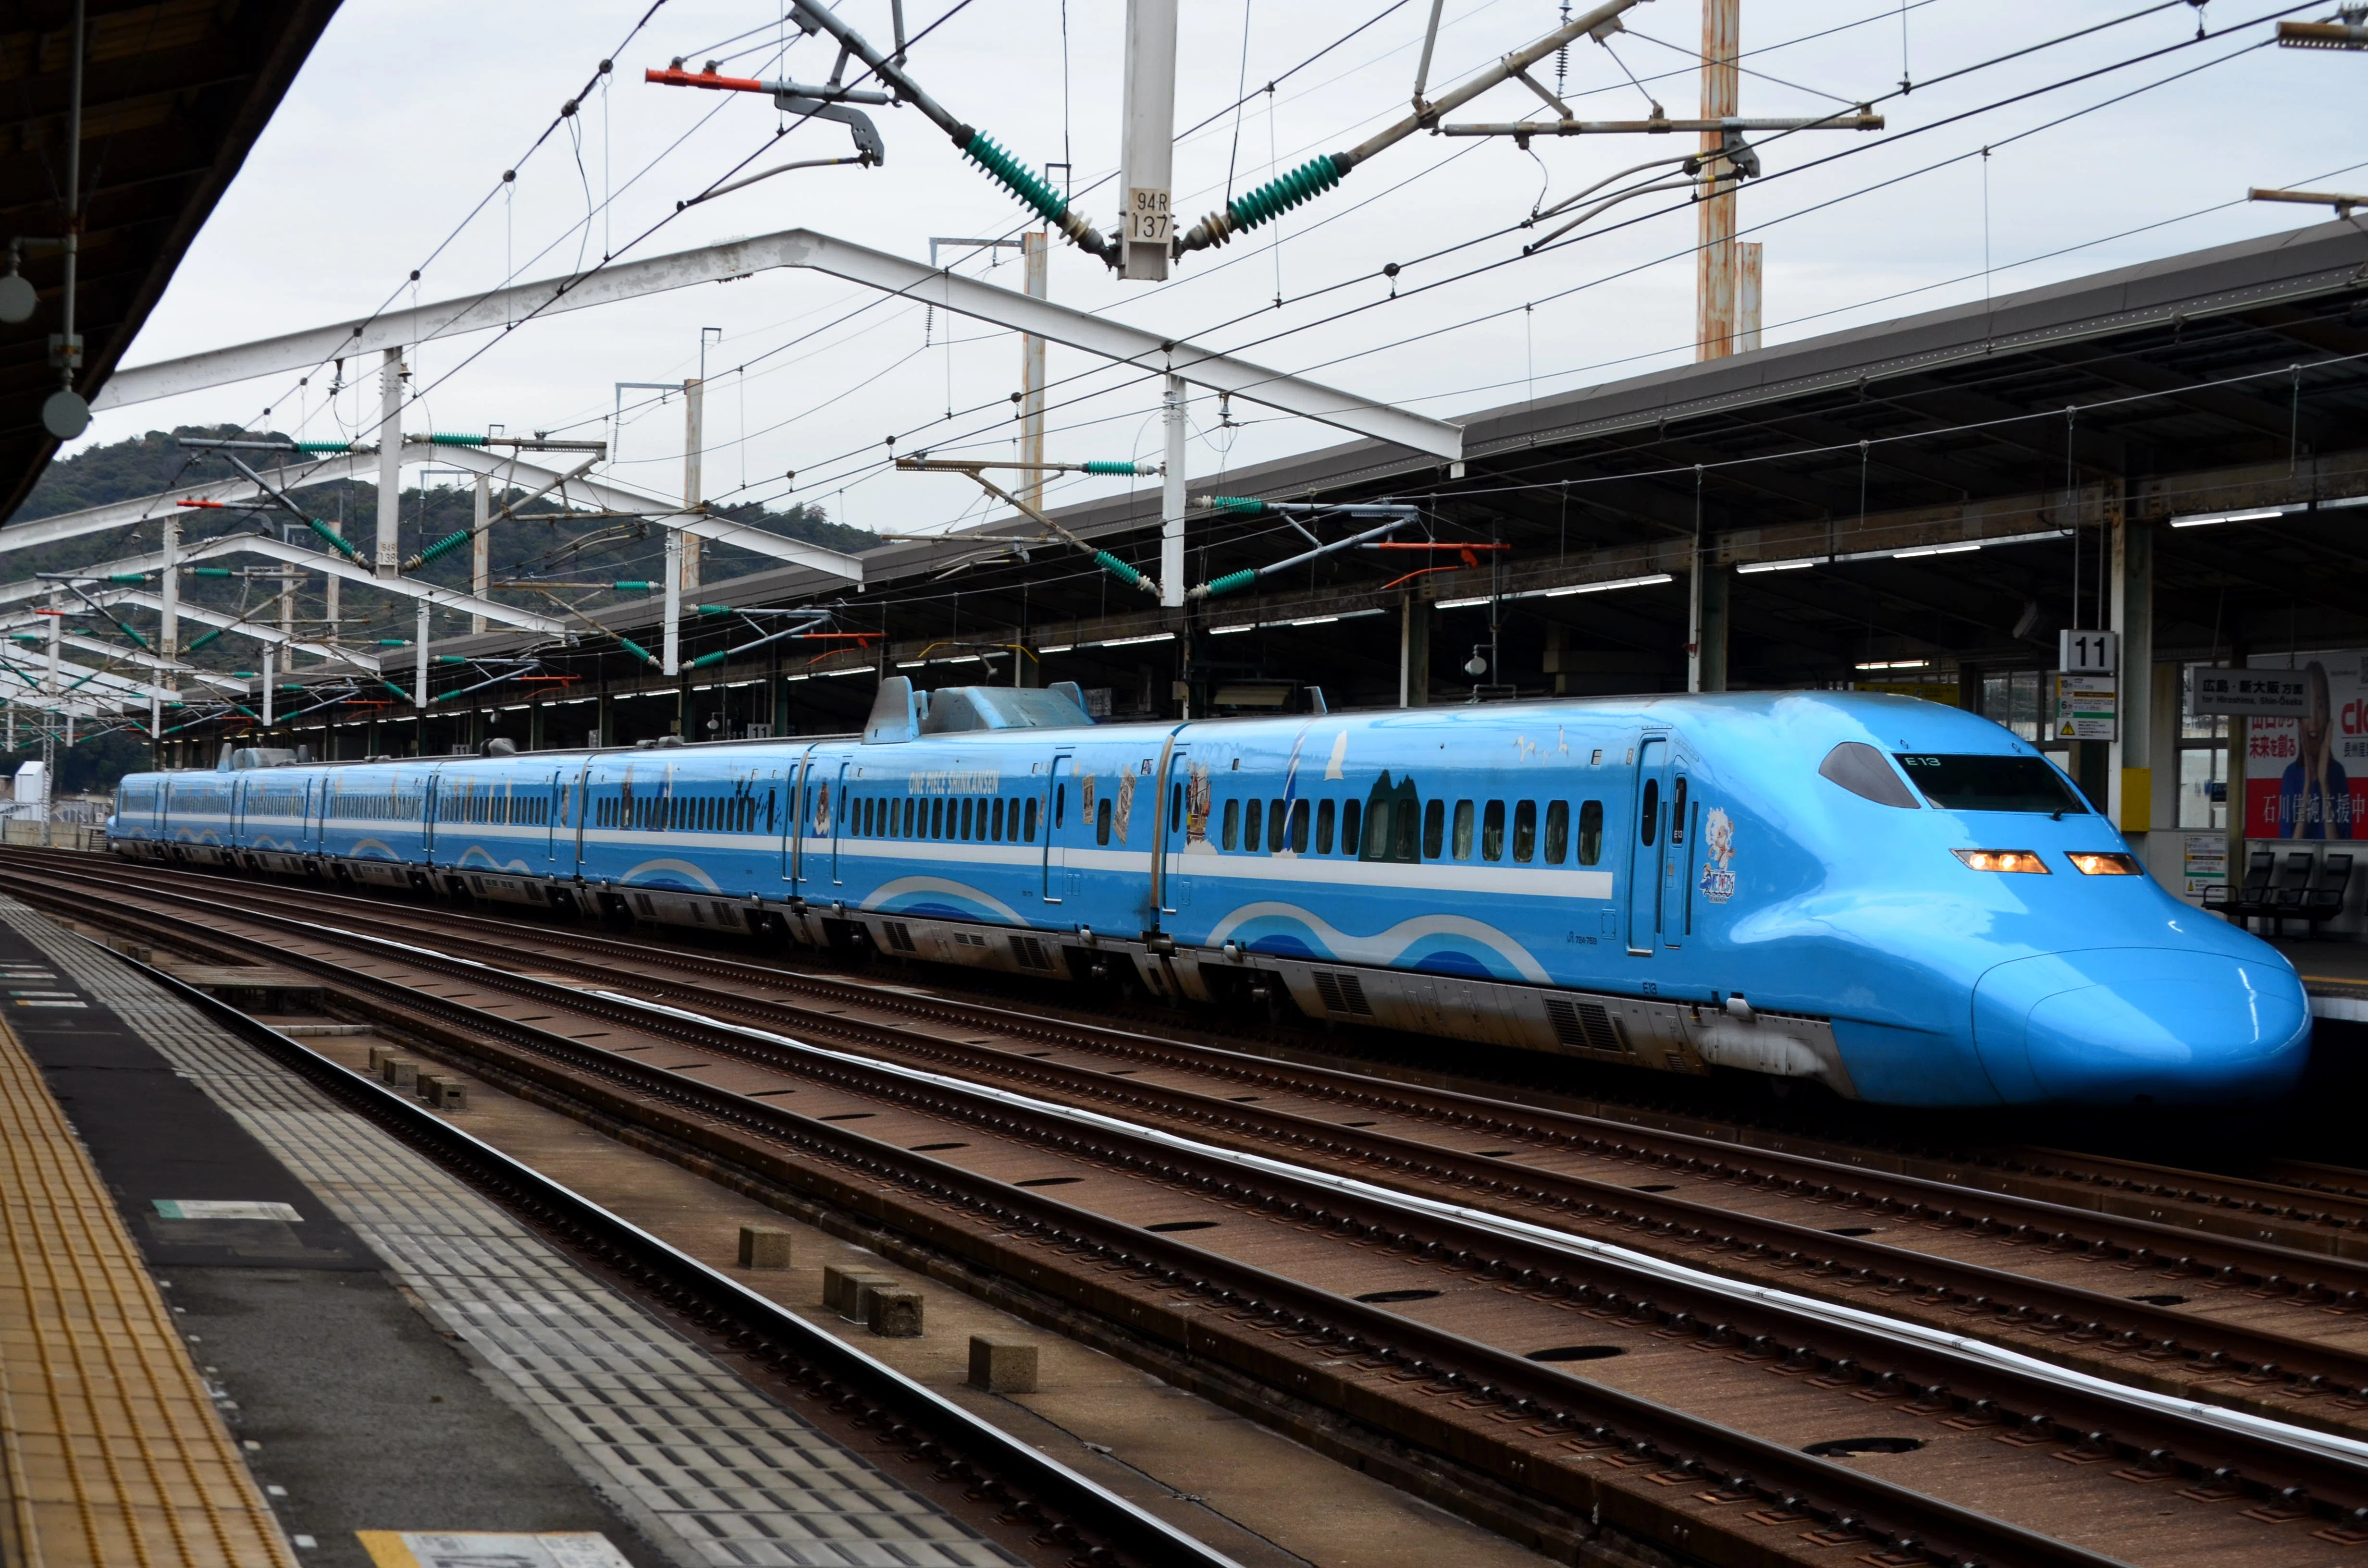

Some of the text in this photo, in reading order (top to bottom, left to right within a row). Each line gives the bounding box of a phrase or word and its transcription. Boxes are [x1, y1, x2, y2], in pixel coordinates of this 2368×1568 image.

[1135, 214, 1167, 238] 137
[380, 552, 396, 563] 138
[2075, 637, 2105, 667] 11
[2341, 698, 2368, 734] cl
[753, 726, 766, 738] 11
[456, 747, 466, 755] 11
[1904, 757, 1941, 766] E13
[909, 770, 999, 795] ONE PIECE SHINKANSEN
[2263, 793, 2365, 823] 石川佳純応援中
[1674, 830, 1683, 838] E13
[1566, 931, 1574, 943] JR
[1642, 982, 1657, 995] E13
